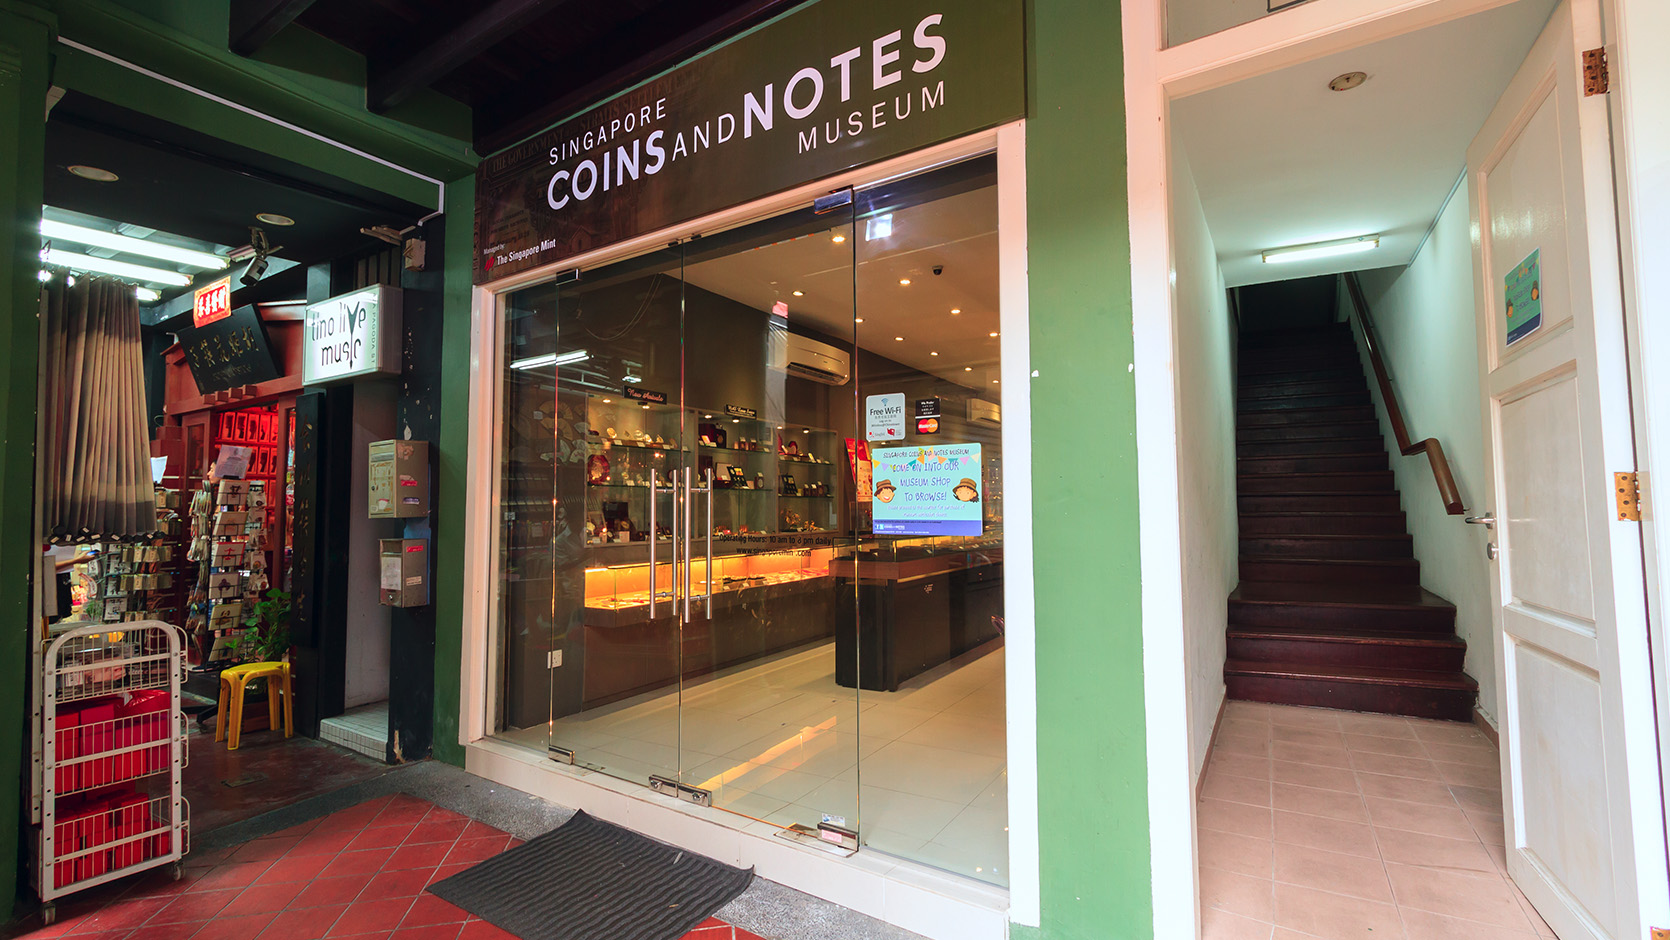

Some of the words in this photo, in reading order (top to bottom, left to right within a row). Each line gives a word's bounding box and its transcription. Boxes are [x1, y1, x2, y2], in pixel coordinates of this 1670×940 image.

[547, 130, 666, 210] COINS
[672, 113, 735, 162] AND
[743, 14, 946, 139] NOTES
[799, 80, 944, 154] MUSEUM
[549, 97, 667, 166] SINGAPORE
[497, 255, 508, 265] The
[509, 245, 539, 262] Singapore
[540, 238, 556, 251] Mint
[311, 312, 335, 342] tino
[339, 301, 366, 334] live
[321, 338, 362, 369] music
[870, 408, 884, 416] Free
[884, 406, 902, 415] Wi-Fi
[883, 451, 908, 459] SINGAPORE
[909, 450, 923, 458] COINS
[924, 449, 933, 457] AND
[934, 449, 949, 457] NOTES
[949, 448, 970, 456] MUSEUM
[893, 463, 910, 472] COME
[912, 462, 922, 472] ON
[924, 461, 942, 472] INTO
[944, 459, 960, 471] OUR
[900, 478, 929, 488] MUSEUM
[931, 476, 951, 488] SHOP
[905, 492, 913, 502] TO
[915, 491, 947, 502] BROWSE!
[719, 534, 747, 544] Operating
[748, 535, 768, 543] Hours:
[789, 535, 796, 543] to
[804, 537, 814, 545] pm
[815, 537, 832, 547] daily
